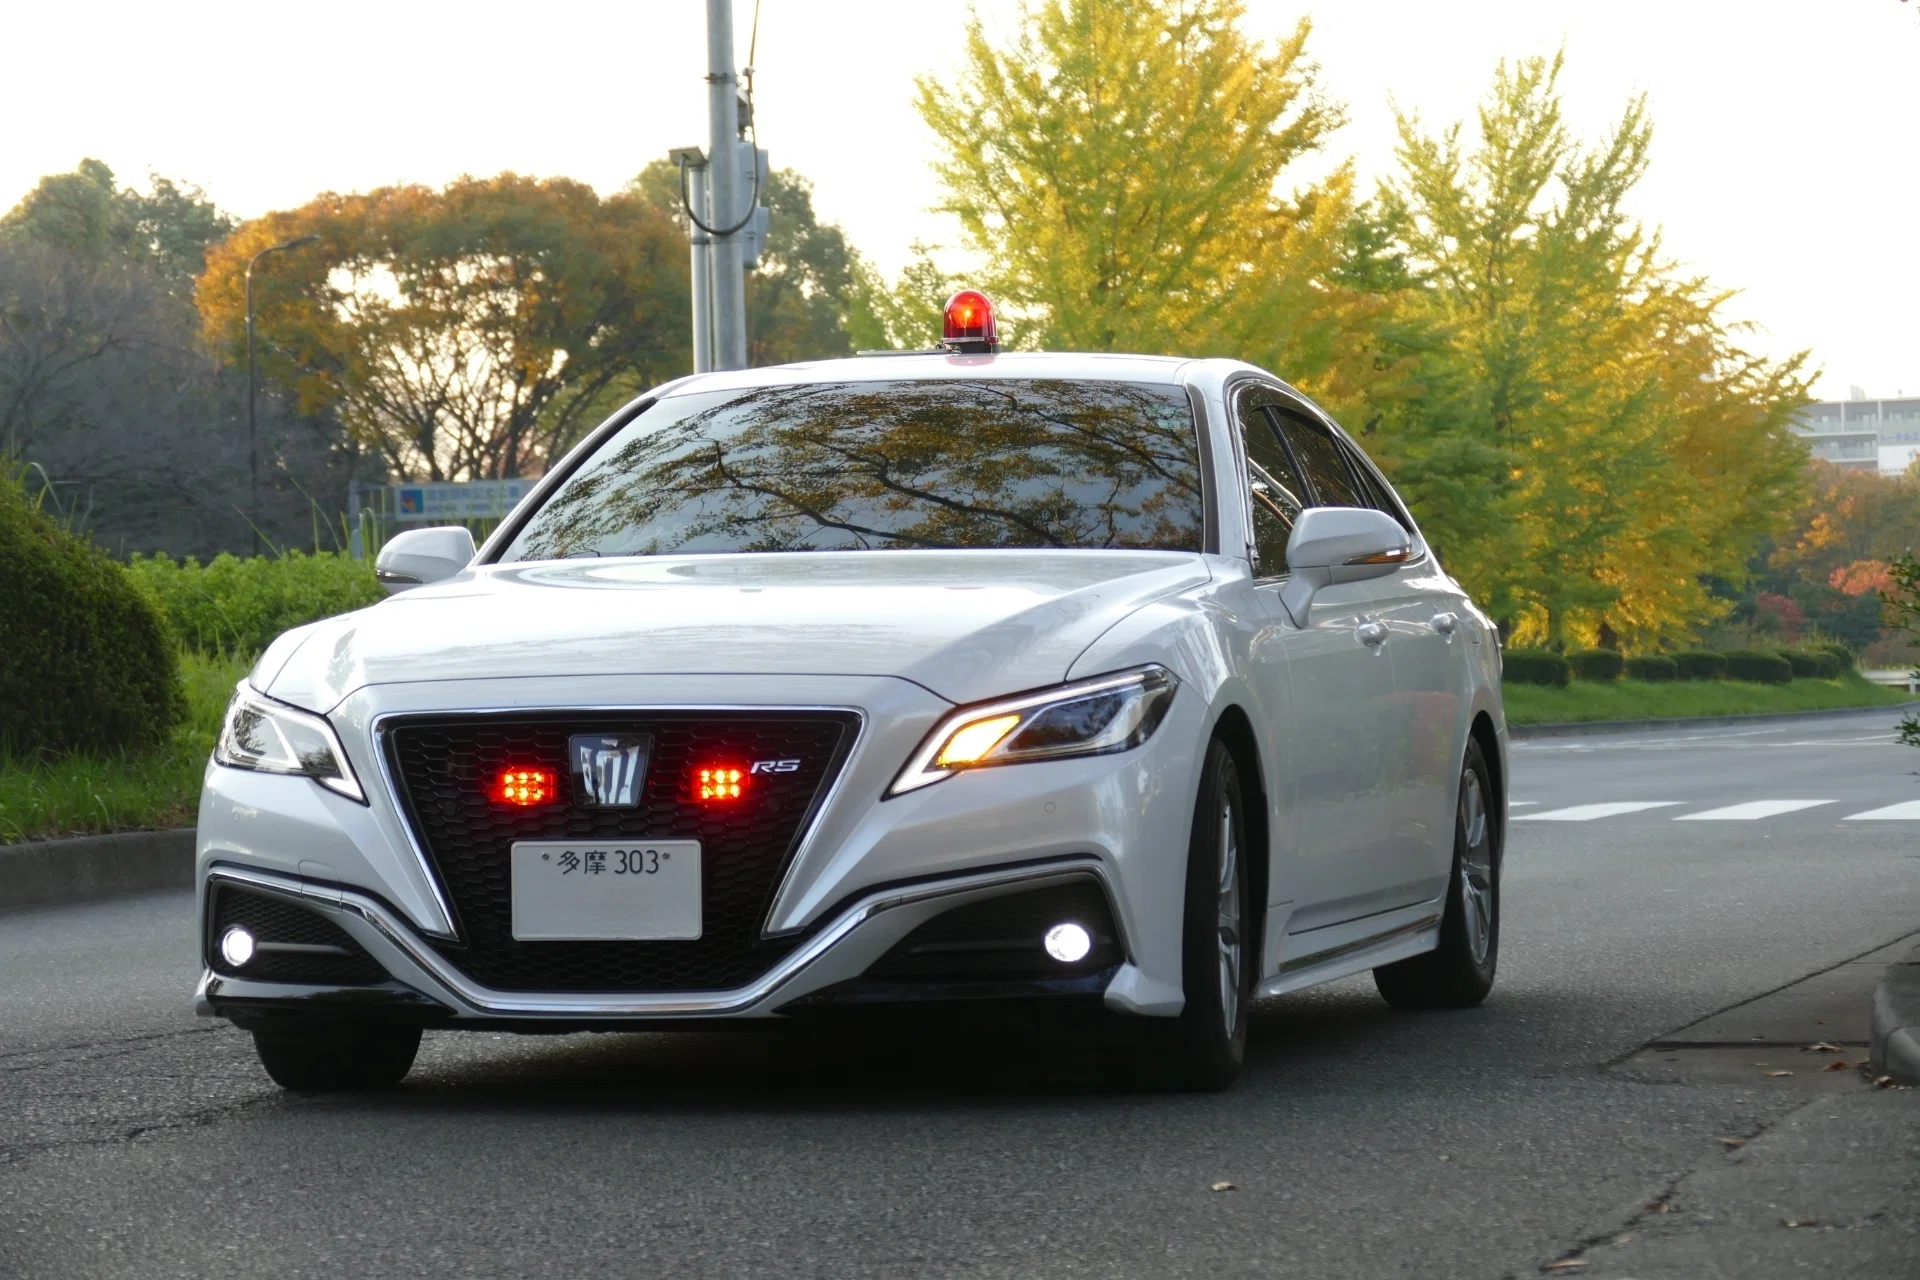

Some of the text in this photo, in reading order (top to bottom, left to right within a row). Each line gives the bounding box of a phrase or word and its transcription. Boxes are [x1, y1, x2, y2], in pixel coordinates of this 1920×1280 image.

[750, 759, 801, 774] RS
[557, 849, 659, 875] 多摩 303
